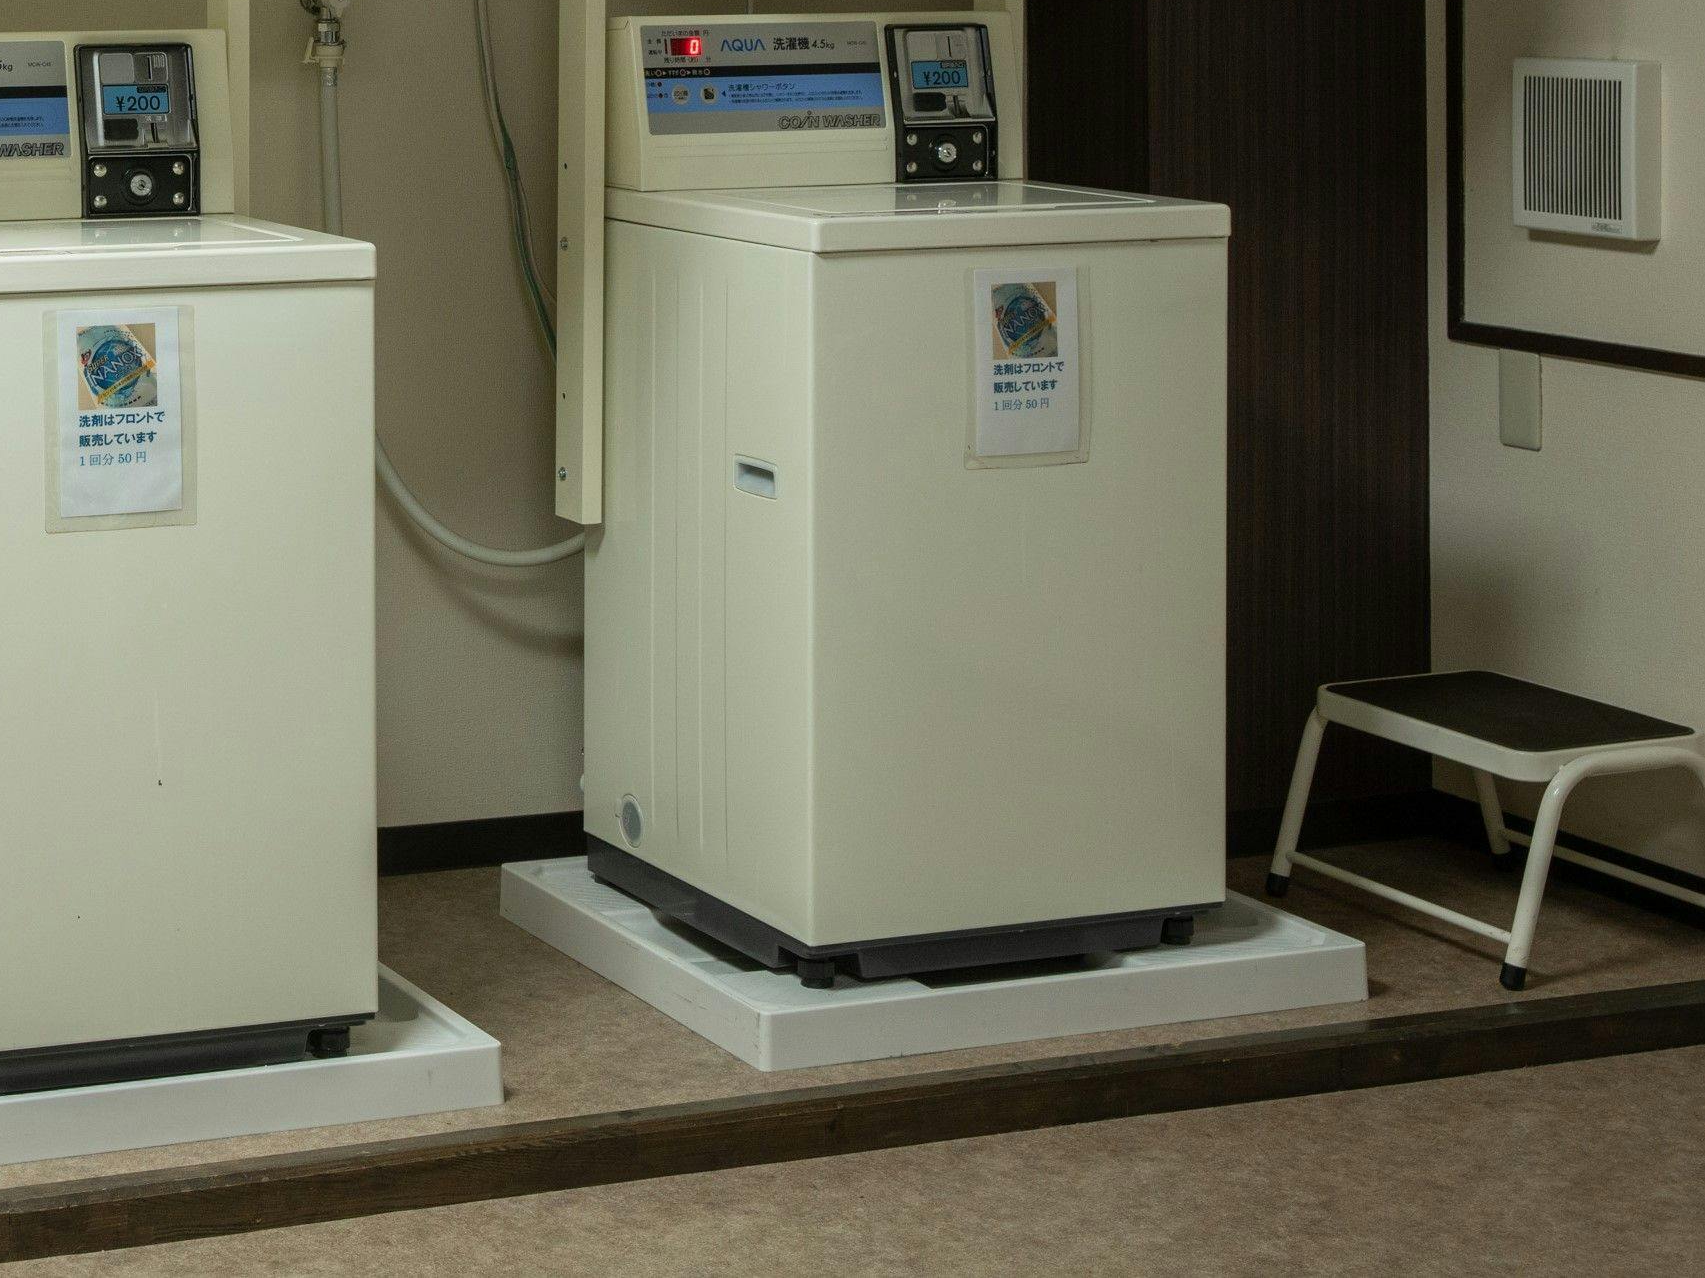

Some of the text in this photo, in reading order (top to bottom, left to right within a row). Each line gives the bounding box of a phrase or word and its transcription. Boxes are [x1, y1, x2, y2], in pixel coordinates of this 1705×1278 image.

[689, 39, 699, 55] 0
[720, 38, 766, 52] AQUA
[773, 36, 835, 51] 洗濯機 4.5kg
[923, 70, 961, 86] ¥200
[115, 95, 161, 112] ¥200
[822, 113, 880, 128] WASHER
[90, 347, 143, 387] NANOX
[993, 360, 1065, 376] 洗剤はフロントで
[993, 378, 1058, 394] 販売しています
[79, 410, 165, 428] 洗剤はフロントで
[79, 431, 157, 448] 販売しています
